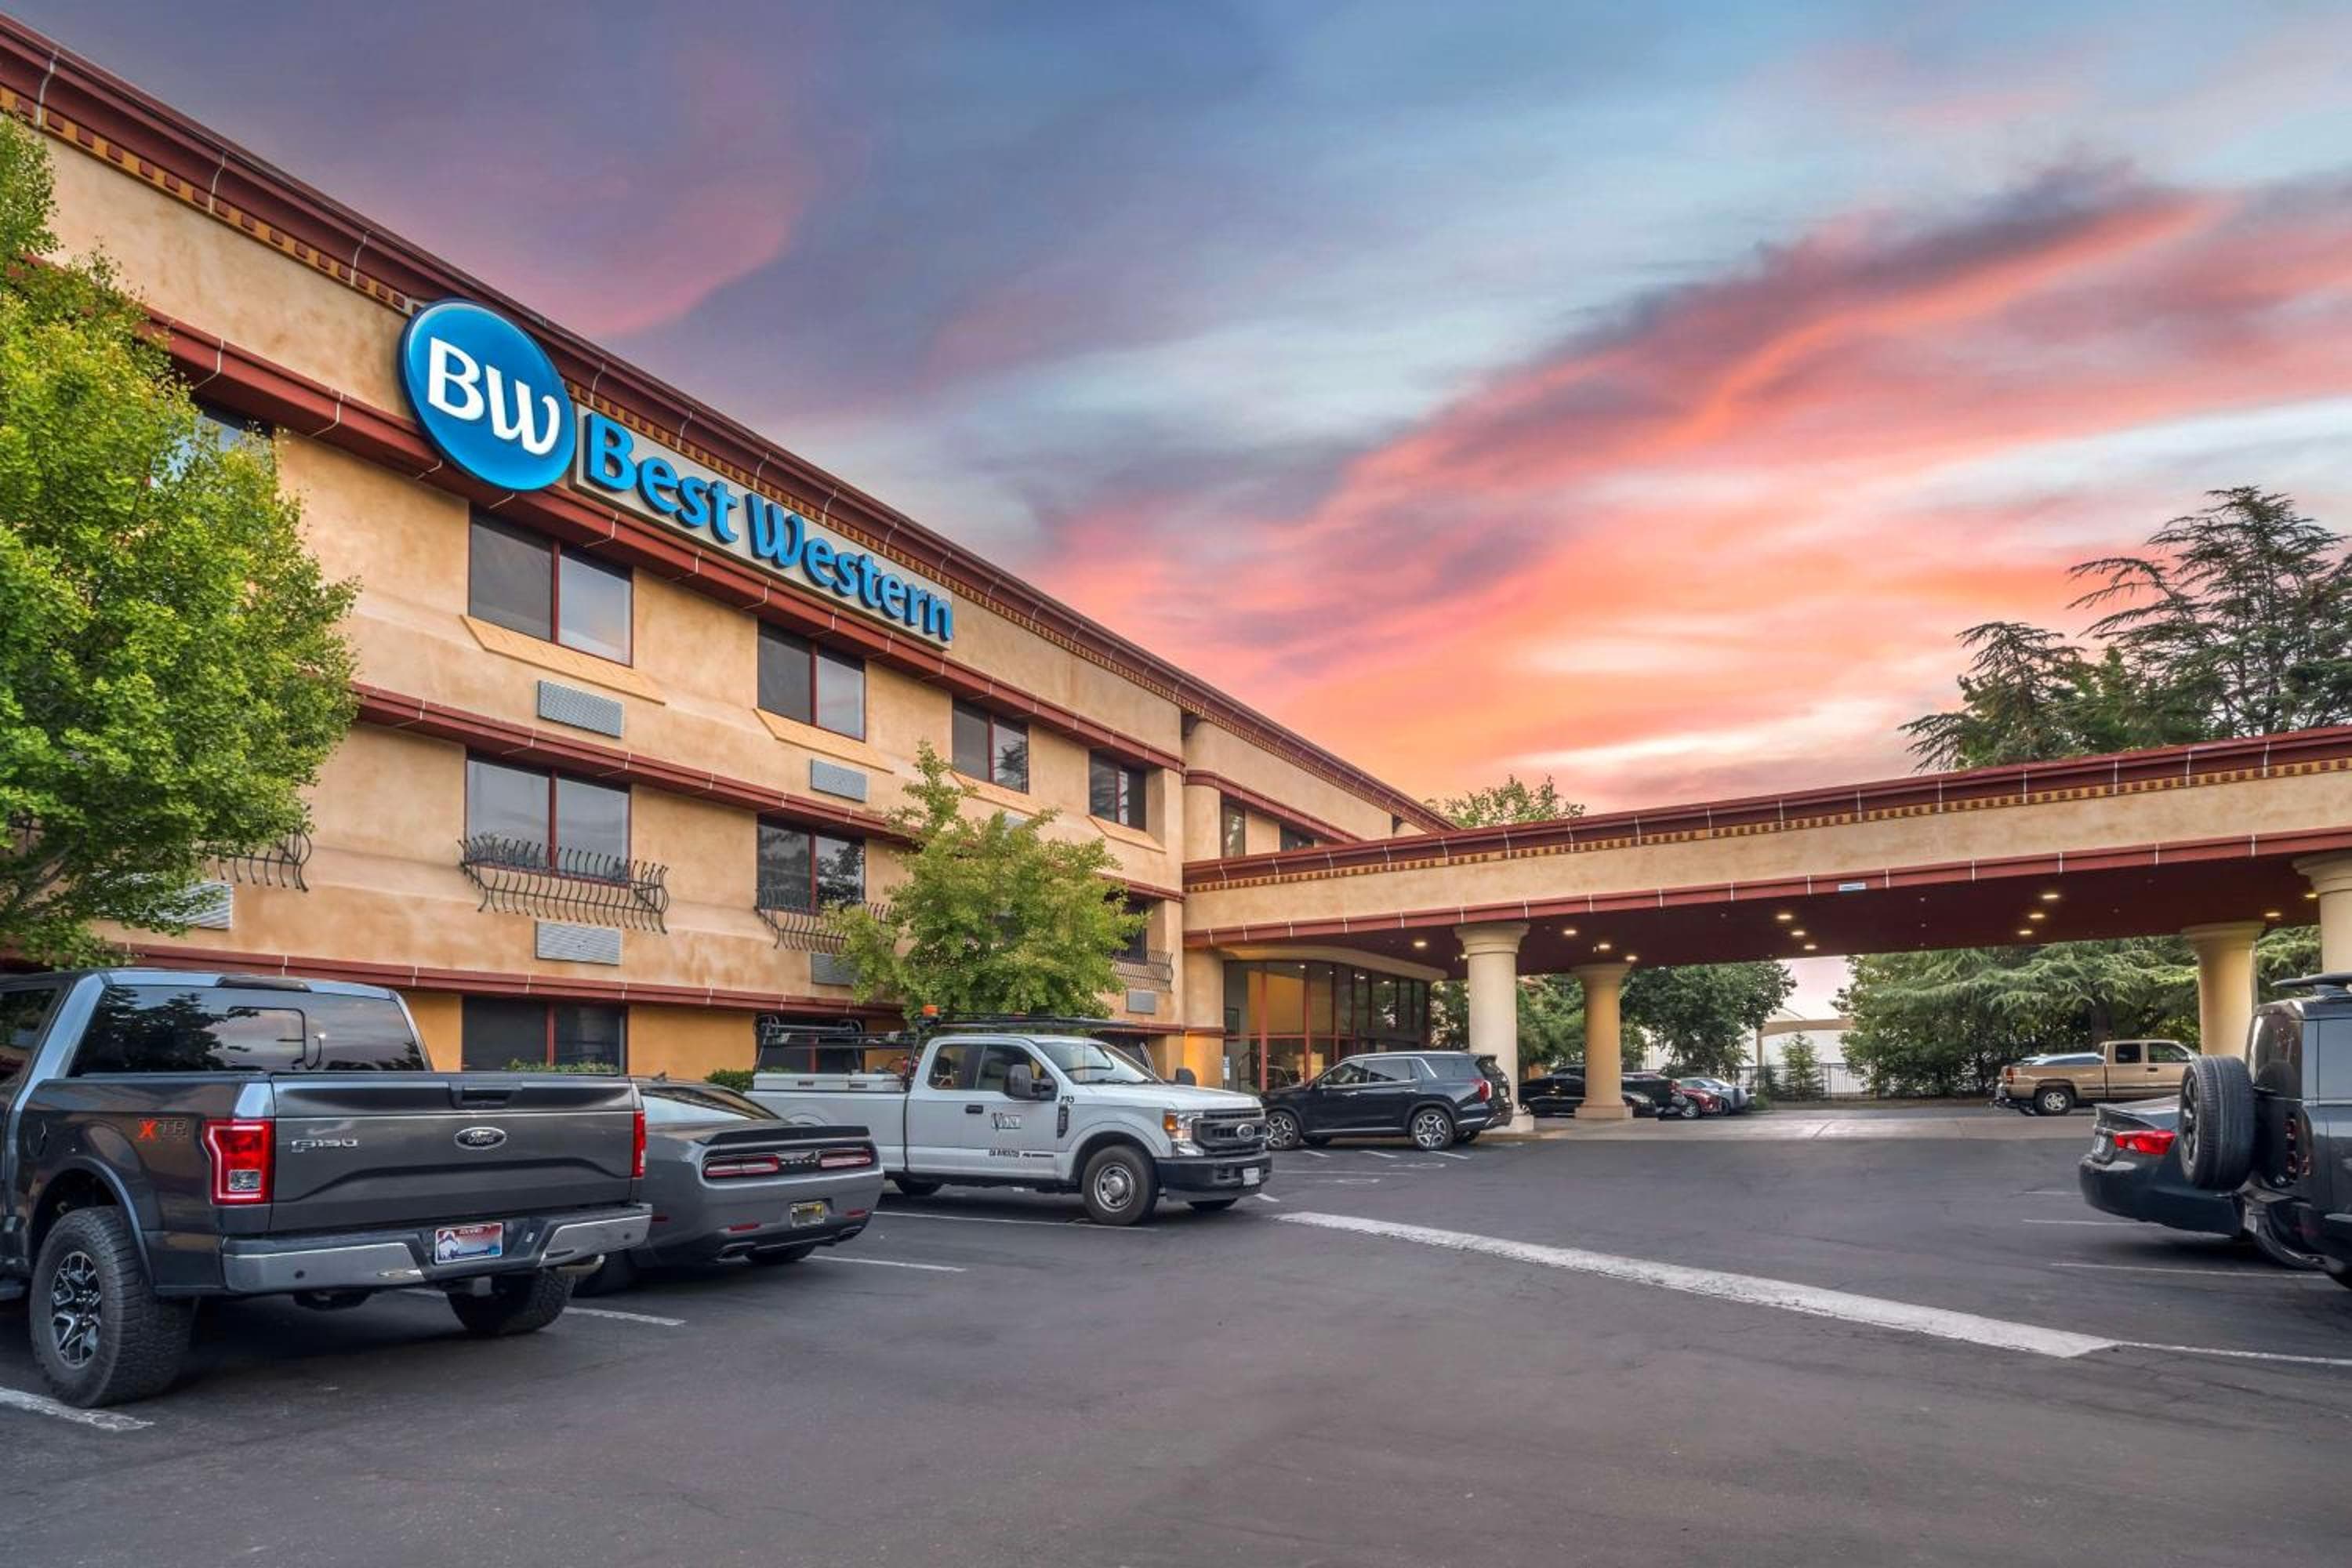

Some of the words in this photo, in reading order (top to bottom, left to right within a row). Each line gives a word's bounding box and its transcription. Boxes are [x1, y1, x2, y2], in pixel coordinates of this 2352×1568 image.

[428, 336, 561, 456] BW
[584, 412, 739, 544] Best
[745, 492, 953, 641] Western
